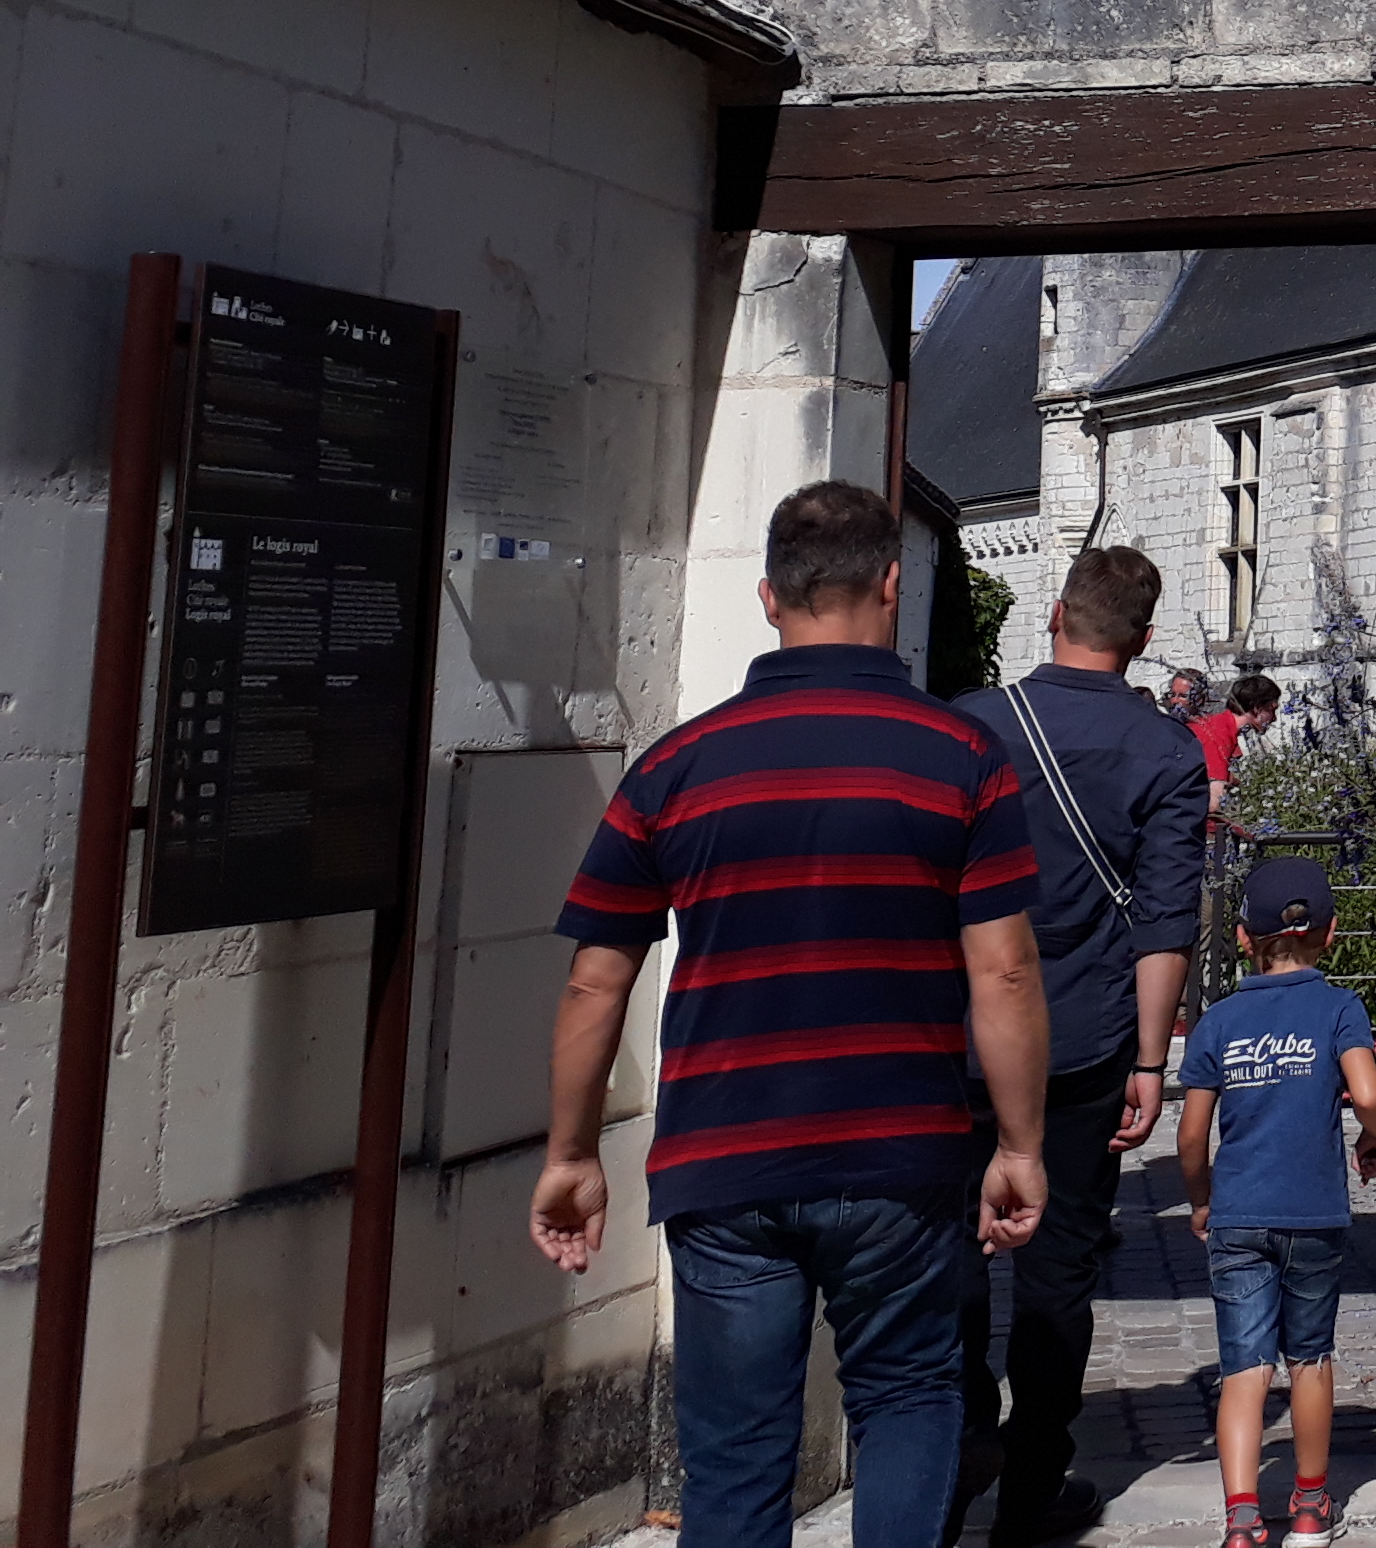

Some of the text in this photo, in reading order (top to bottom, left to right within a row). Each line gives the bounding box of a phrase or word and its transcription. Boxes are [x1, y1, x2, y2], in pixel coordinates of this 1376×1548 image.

[251, 535, 319, 556] Le logis royal
[1254, 1032, 1316, 1065] Cuba
[1224, 1063, 1274, 1083] CHILL OUT
